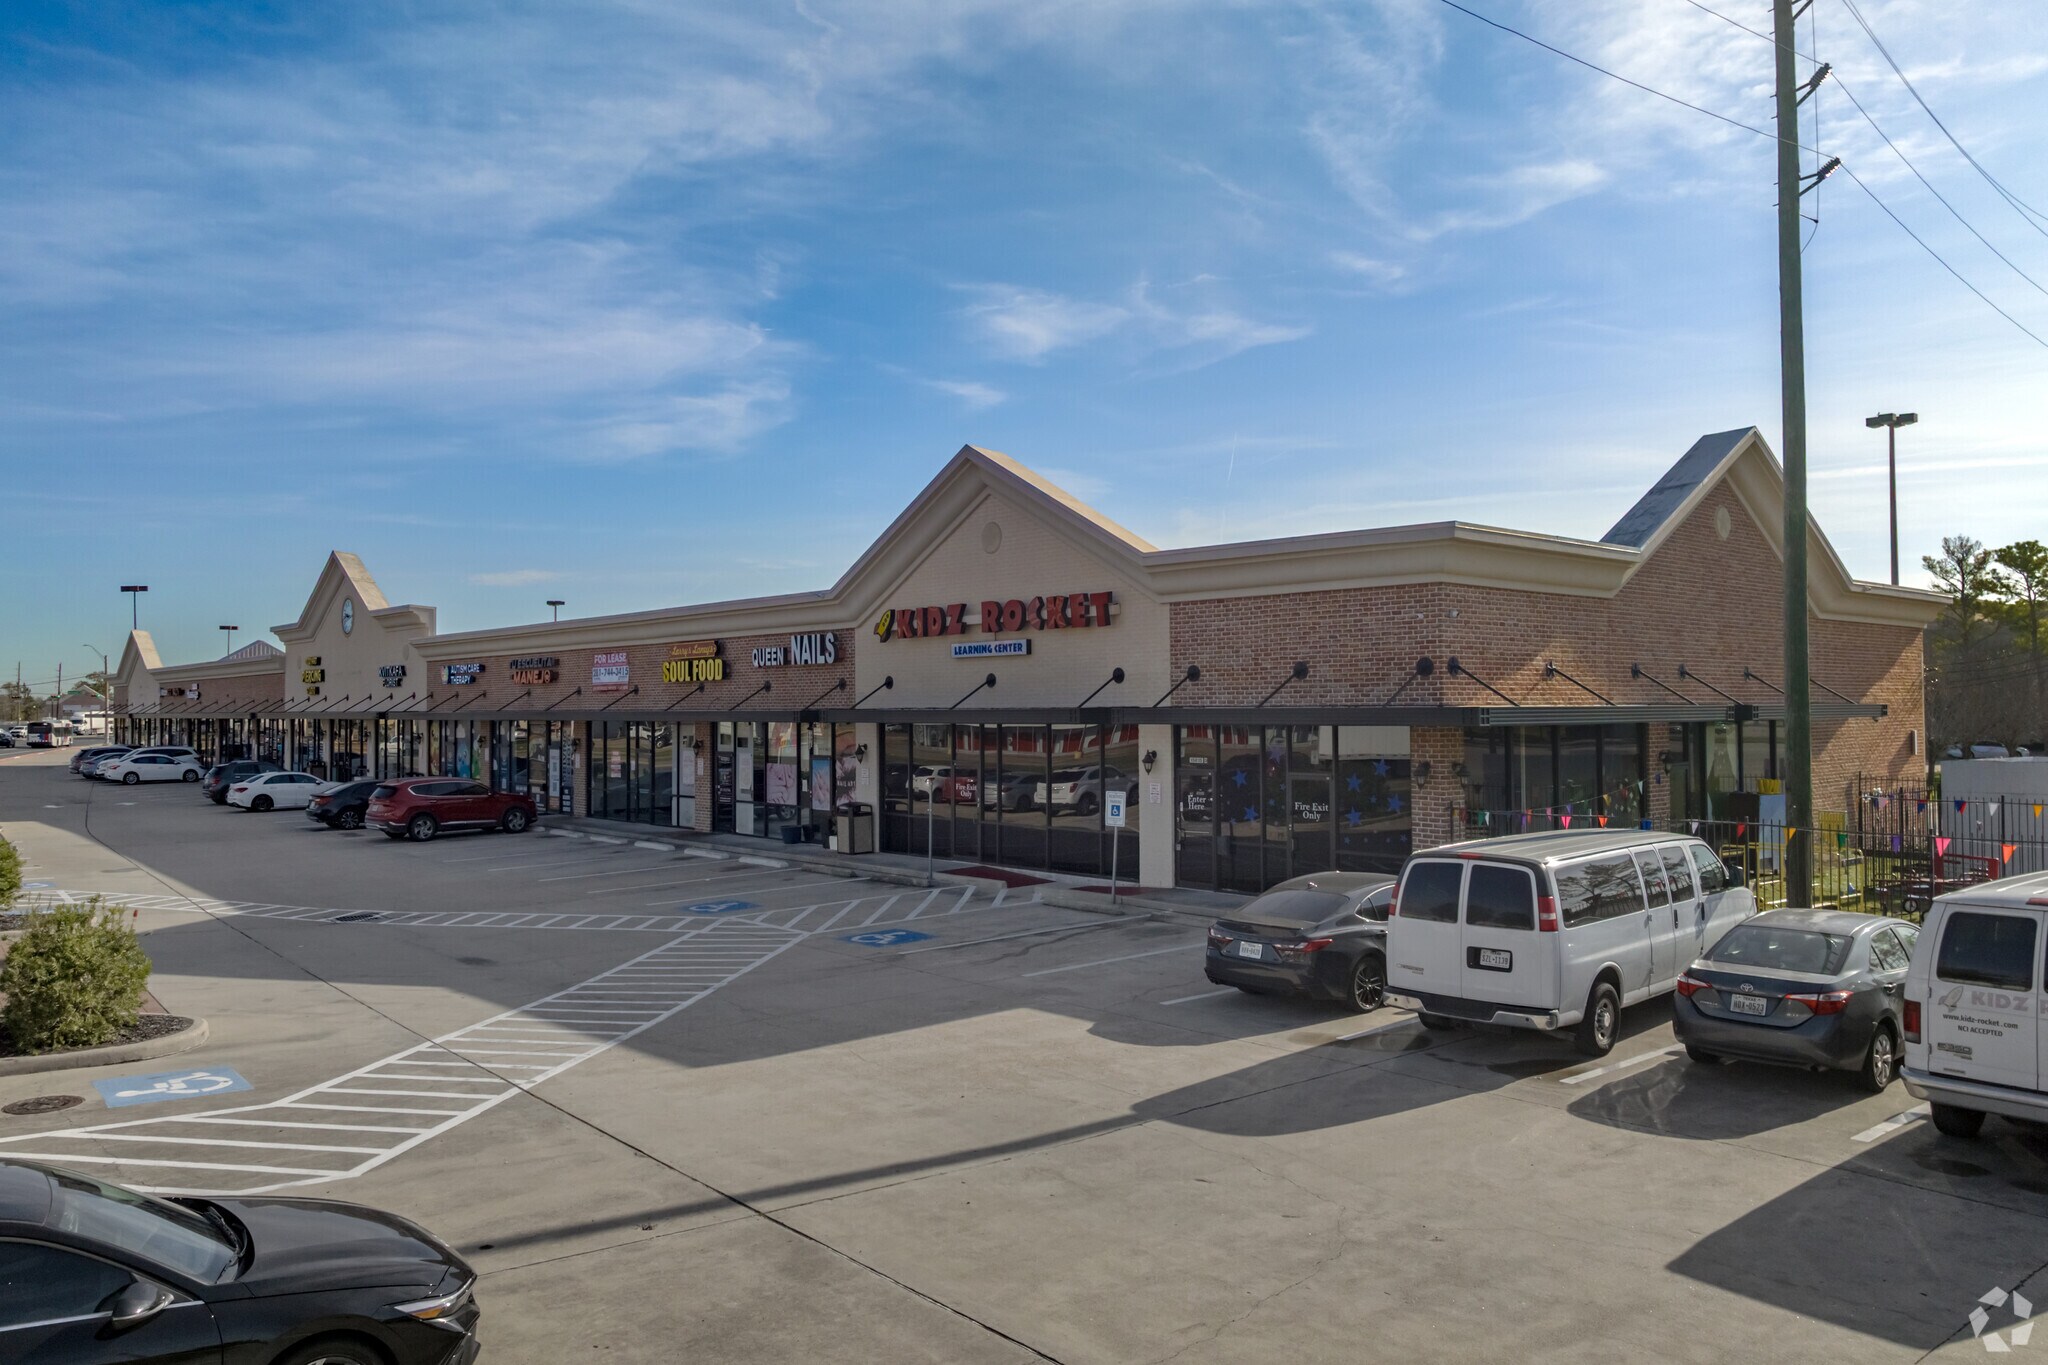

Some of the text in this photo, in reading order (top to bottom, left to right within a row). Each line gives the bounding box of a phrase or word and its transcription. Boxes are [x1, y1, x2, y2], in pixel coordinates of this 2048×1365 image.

[897, 591, 1113, 640] KIDZ ROCKET
[752, 632, 835, 668] QUEEN NAILS
[954, 642, 1023, 655] LEARNING CENTER
[594, 652, 627, 664] FOR LEASE
[512, 669, 551, 685] MANEJO
[662, 658, 723, 684] SOUL FOOD
[967, 783, 977, 791] Exit
[960, 790, 973, 799] Only
[1188, 795, 1206, 803] Enter
[1188, 802, 1205, 810] Here
[1294, 802, 1329, 811] Fire Exit
[1302, 810, 1321, 822] Only
[1971, 990, 2029, 1012] KIDZ
[1957, 1025, 2003, 1037] NCI ACCEPTED
